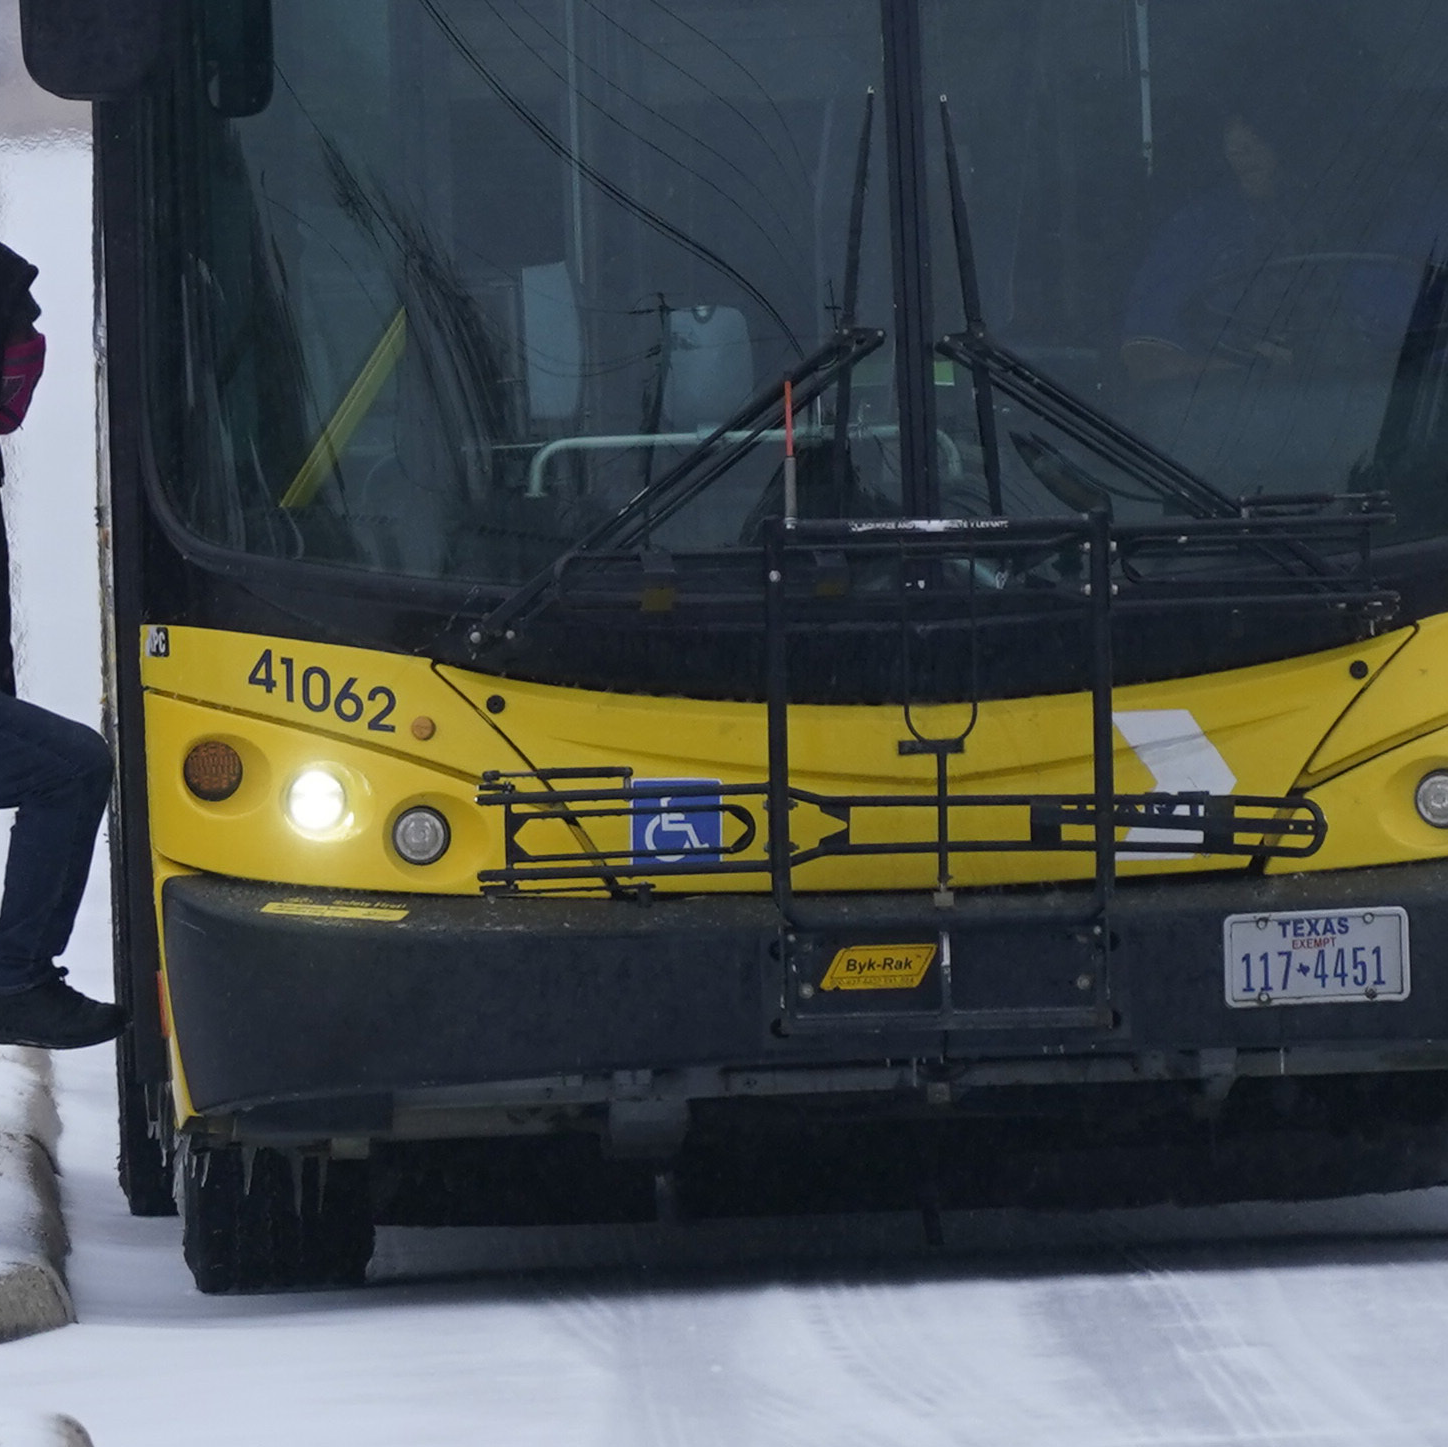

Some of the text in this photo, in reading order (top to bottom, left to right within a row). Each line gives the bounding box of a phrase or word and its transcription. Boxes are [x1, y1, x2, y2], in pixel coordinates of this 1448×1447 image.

[248, 649, 397, 733] 41062
[1278, 916, 1350, 939] TEXAS
[1291, 936, 1337, 950] EXEMPT
[846, 956, 913, 974] Byk-Rak
